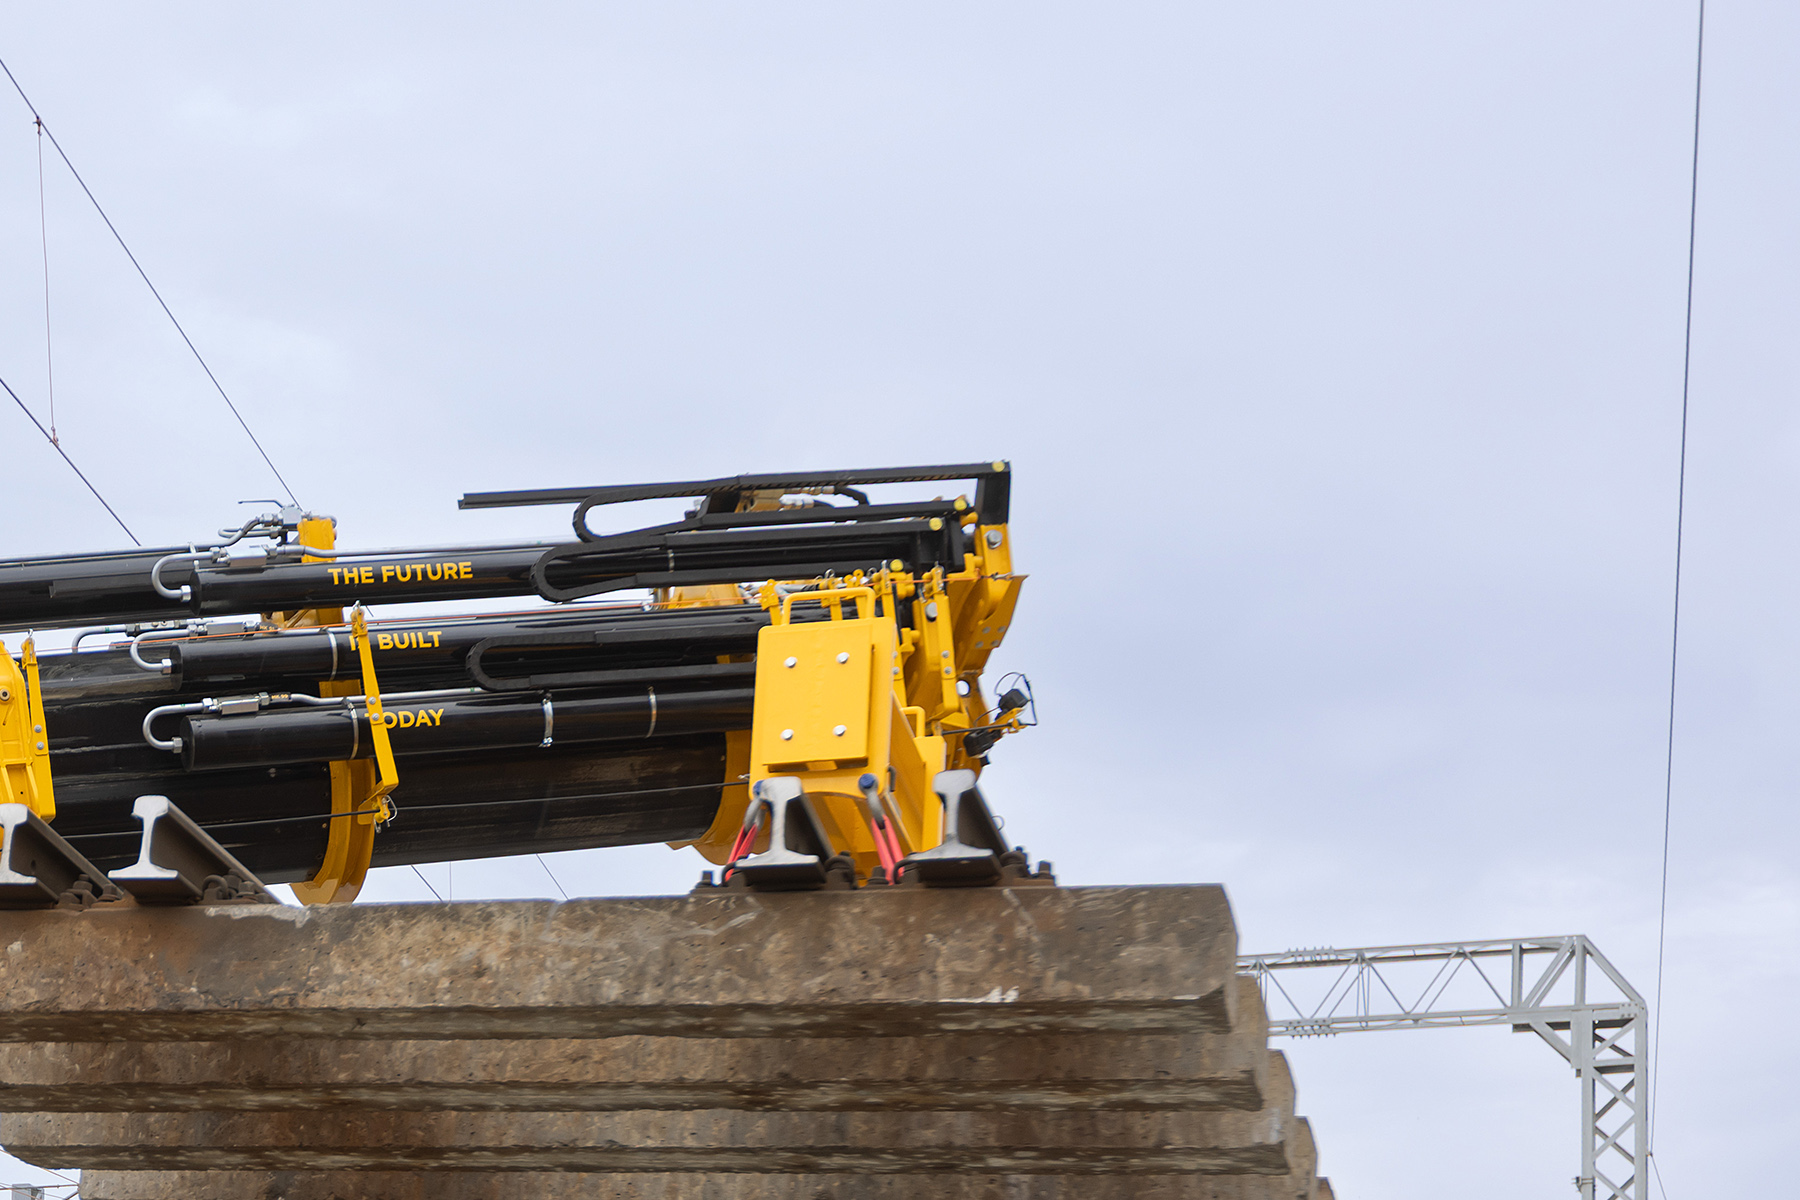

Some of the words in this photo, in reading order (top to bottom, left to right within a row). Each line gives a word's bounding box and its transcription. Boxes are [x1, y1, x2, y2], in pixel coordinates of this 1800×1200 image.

[327, 566, 375, 585] THE
[381, 561, 473, 583] FUTURE
[377, 631, 442, 650] BUILT
